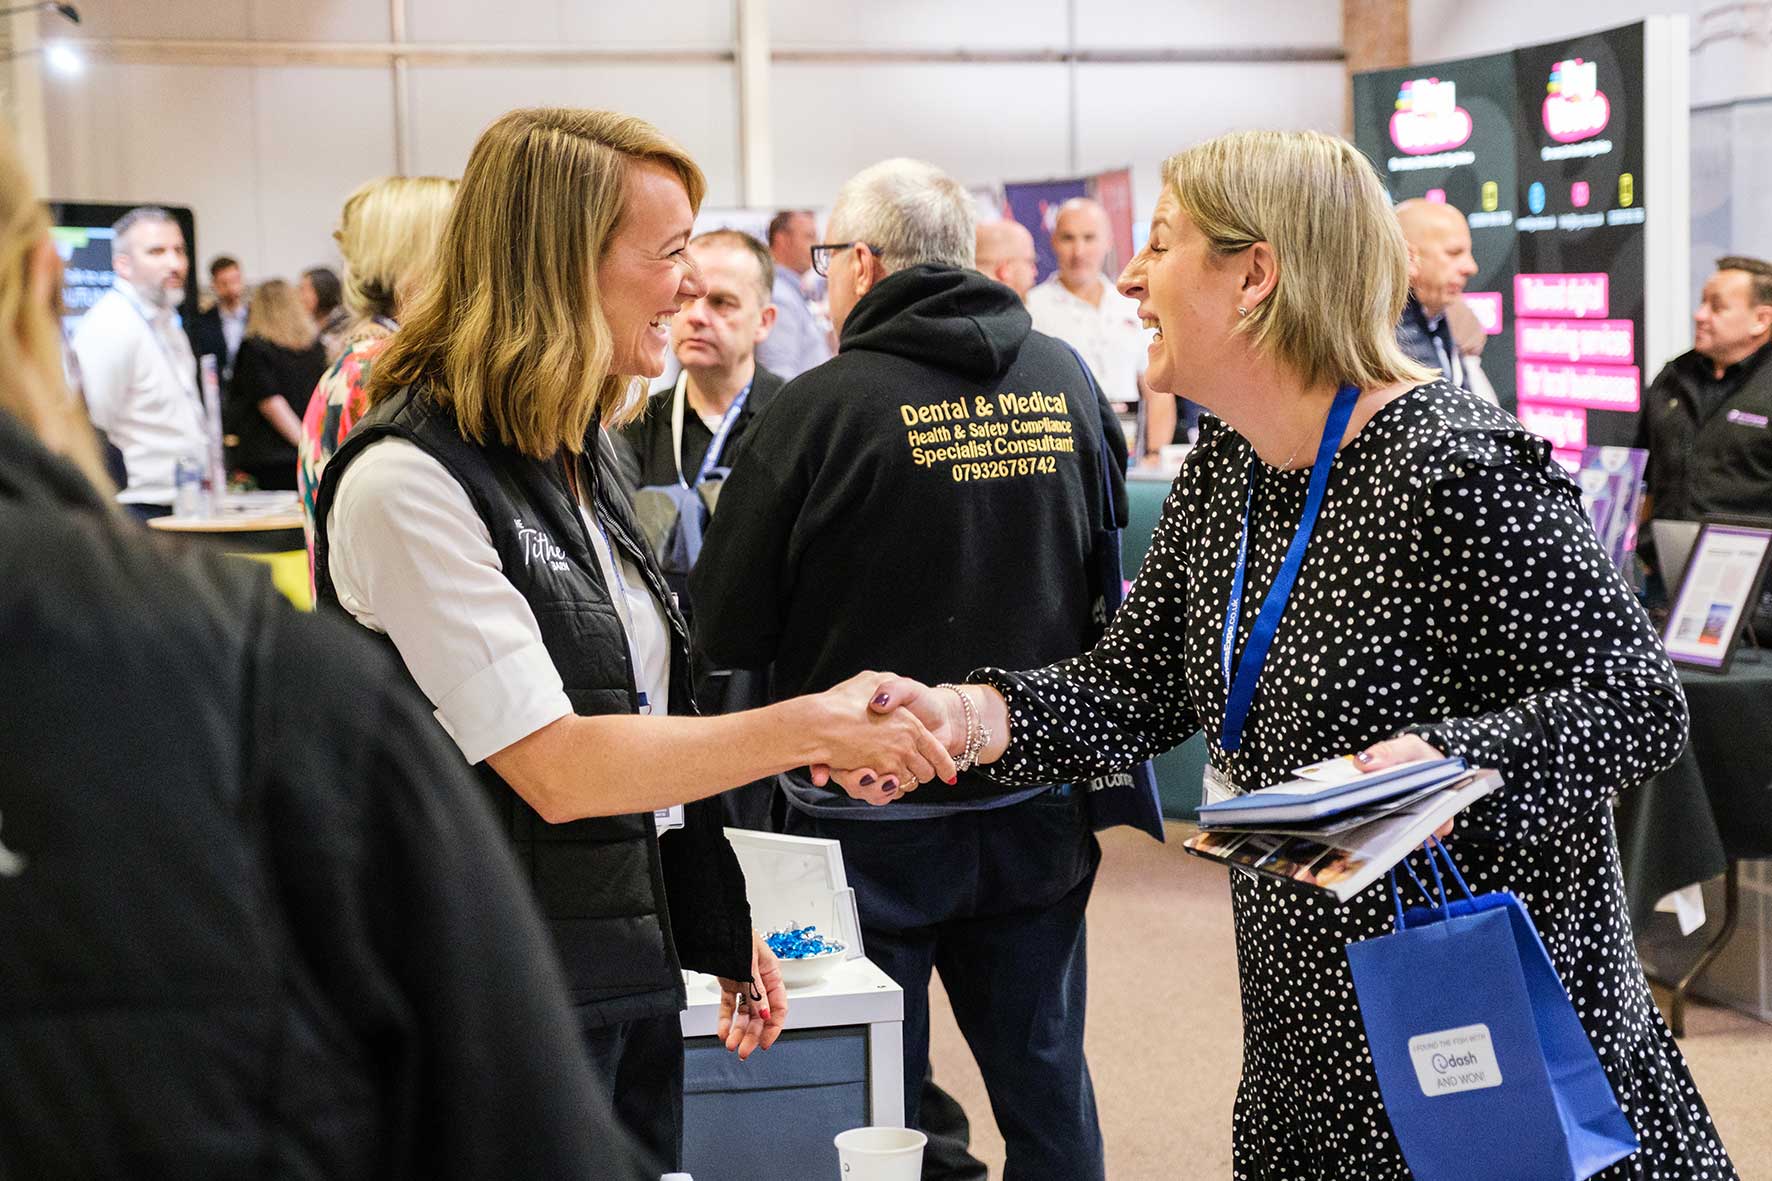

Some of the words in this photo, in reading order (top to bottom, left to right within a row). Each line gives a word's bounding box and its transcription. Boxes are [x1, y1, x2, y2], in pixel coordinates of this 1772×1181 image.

[900, 396, 970, 427] Dental
[975, 395, 994, 417] &
[998, 391, 1069, 416] Medical
[908, 425, 951, 447] Health
[954, 425, 966, 440] &
[970, 421, 1009, 439] Safety
[1012, 417, 1073, 435] Compliance
[912, 439, 994, 468] Specialist
[995, 435, 1074, 455] Consultant
[952, 456, 1057, 482] 07932678742
[519, 529, 565, 565] Tithe
[1223, 598, 1239, 687] inessExpo.co.uk
[1440, 1040, 1452, 1048] THE
[1437, 1077, 1457, 1089] AND
[1458, 1072, 1485, 1085] WON!
